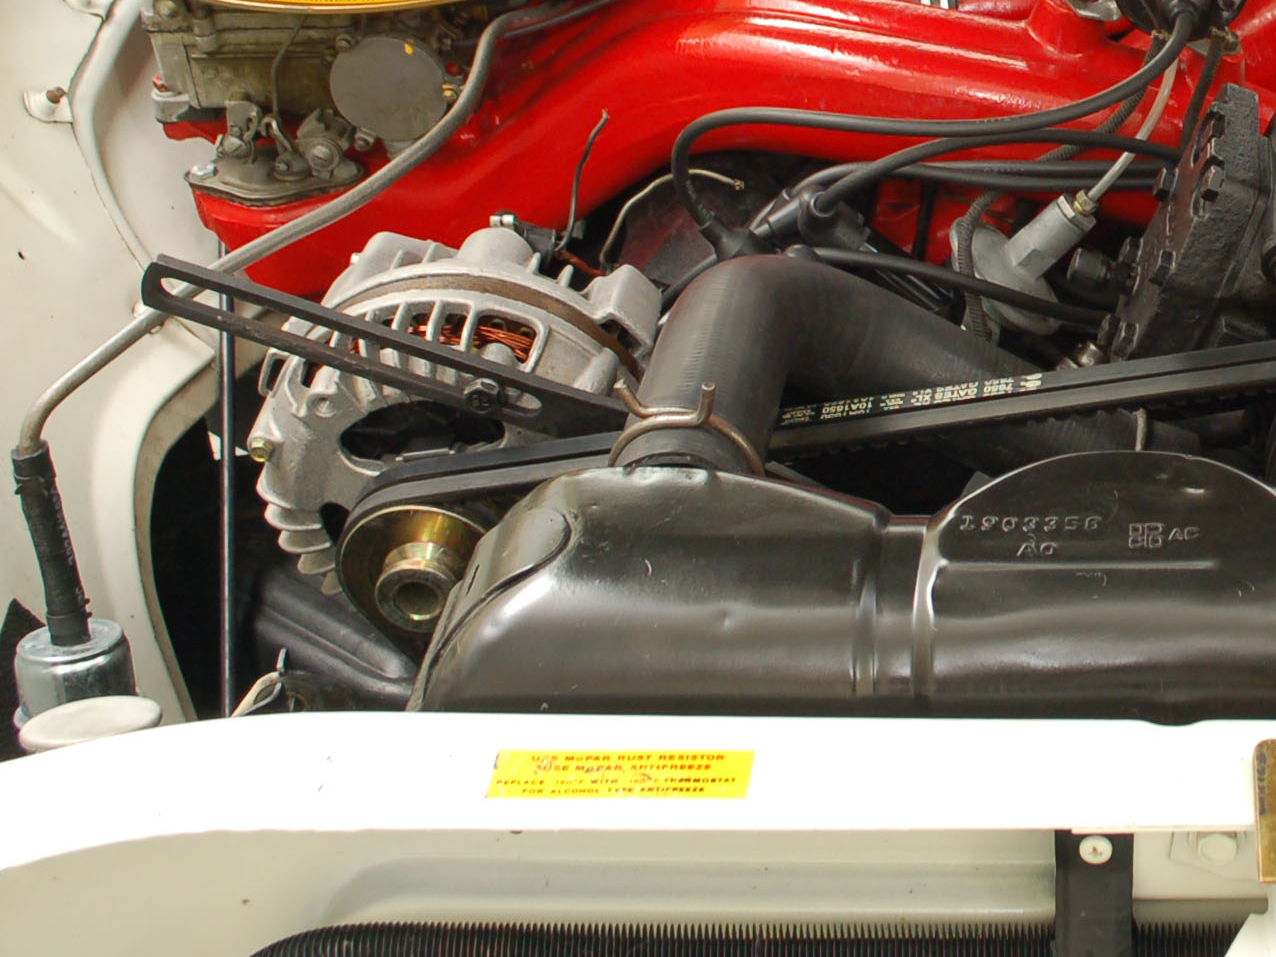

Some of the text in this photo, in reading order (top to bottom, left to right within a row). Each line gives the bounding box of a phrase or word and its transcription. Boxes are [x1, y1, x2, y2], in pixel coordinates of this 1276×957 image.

[617, 753, 653, 762] RUST
[658, 753, 726, 762] RESISTOR
[630, 763, 713, 772] ANTIFREEZE
